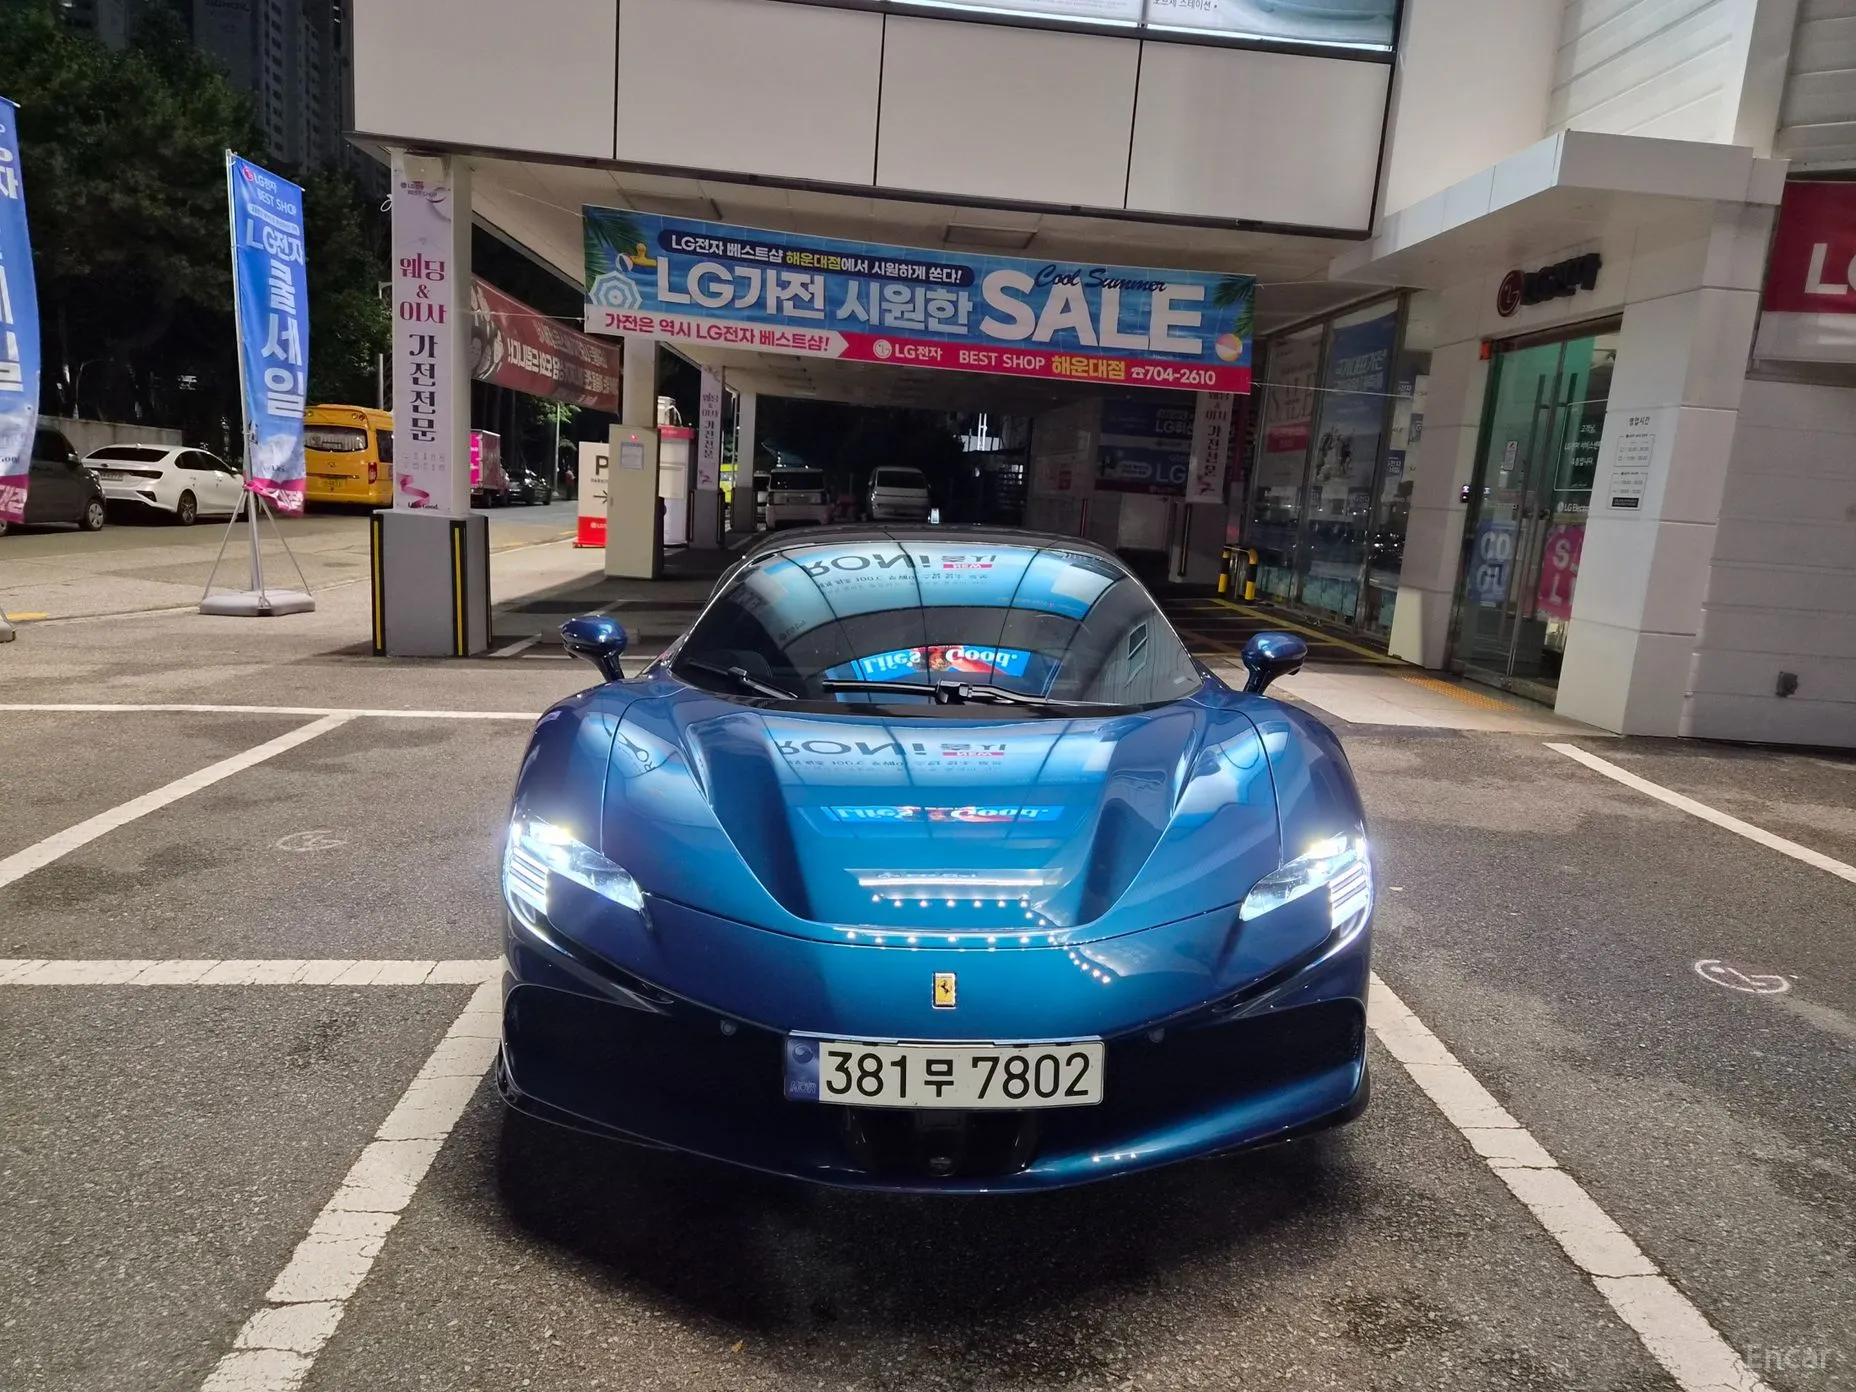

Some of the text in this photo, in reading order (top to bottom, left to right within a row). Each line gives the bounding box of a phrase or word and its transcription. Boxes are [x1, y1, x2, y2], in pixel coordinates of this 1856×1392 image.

[246, 218, 304, 266] LG전자
[671, 235, 724, 254] LG전자
[727, 243, 783, 265] 베스트샵
[786, 250, 868, 274] 해운대점에서
[871, 260, 926, 280] 시원하게
[399, 253, 446, 282] 웨딩
[1035, 264, 1167, 293] Cool Summer
[416, 284, 431, 300] &
[657, 256, 973, 336] LG가전 시원한
[399, 301, 447, 325] 이사
[605, 312, 655, 334] 가전은
[659, 317, 692, 338] 역시
[696, 322, 756, 344] LG전자
[979, 269, 1206, 355] SALE
[895, 345, 1217, 386] LG전자 BEST SHOP 해운대점 704-2610
